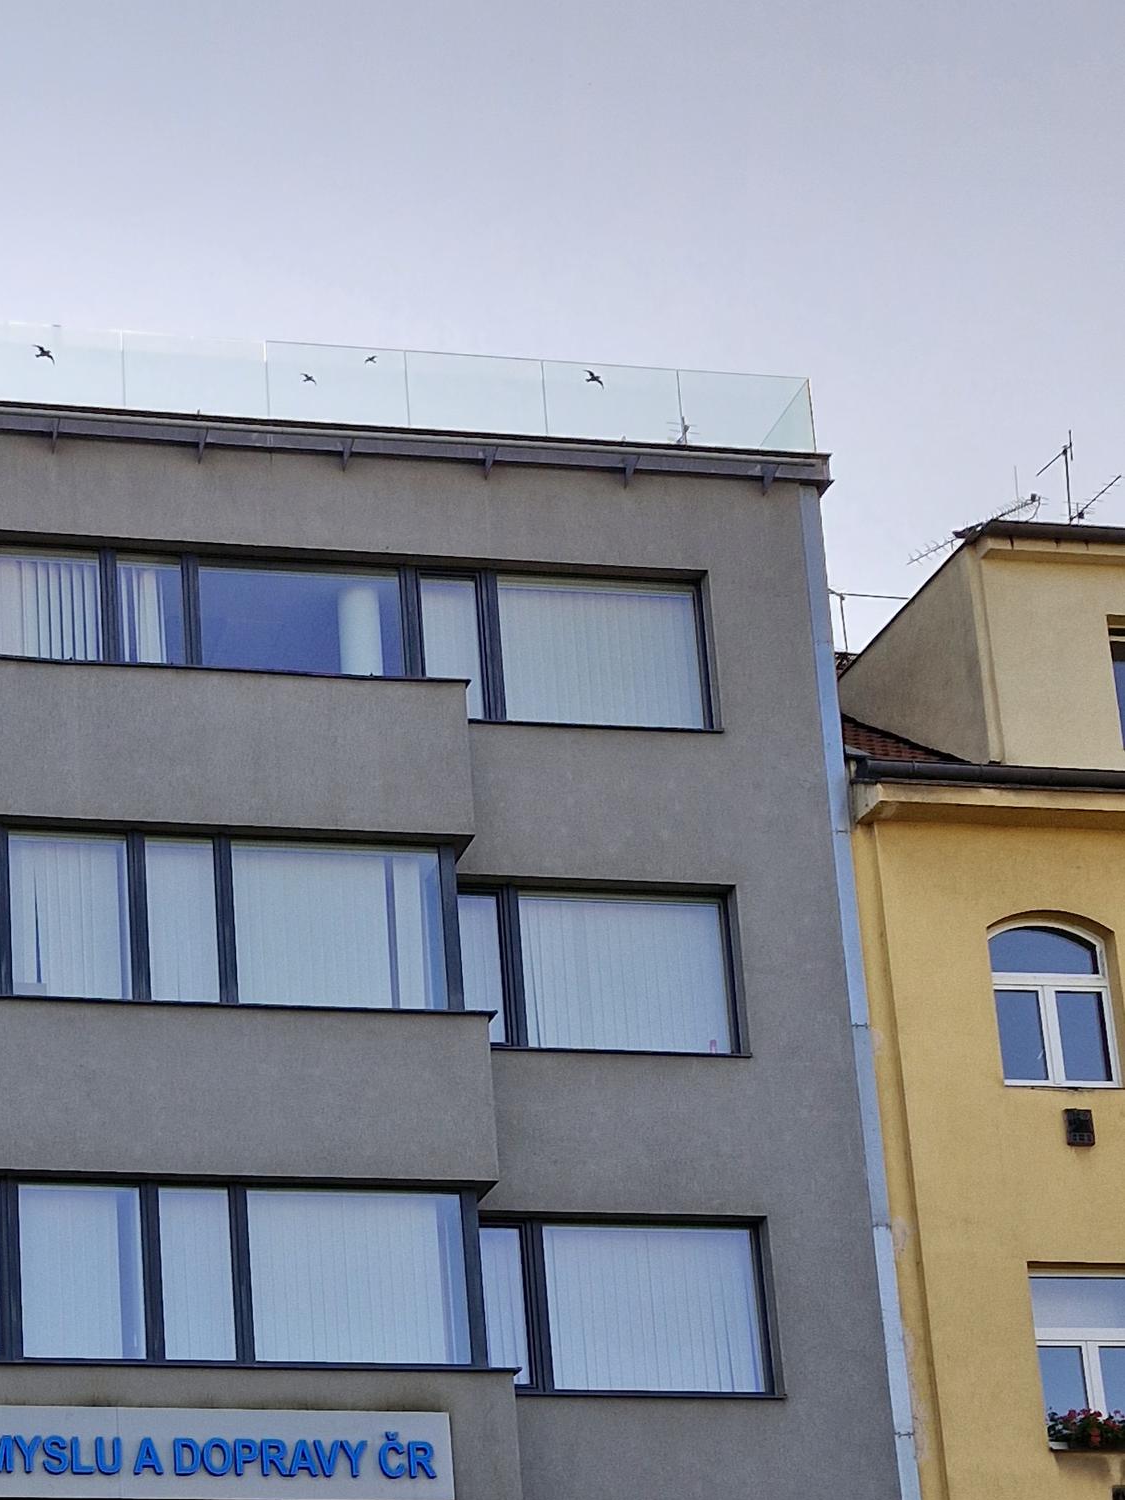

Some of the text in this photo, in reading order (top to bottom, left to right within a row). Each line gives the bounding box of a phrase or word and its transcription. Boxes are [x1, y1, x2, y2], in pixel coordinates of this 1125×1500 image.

[133, 1436, 165, 1475] A
[172, 1436, 368, 1478] DOPRAVY
[378, 1430, 437, 1479] ČR
